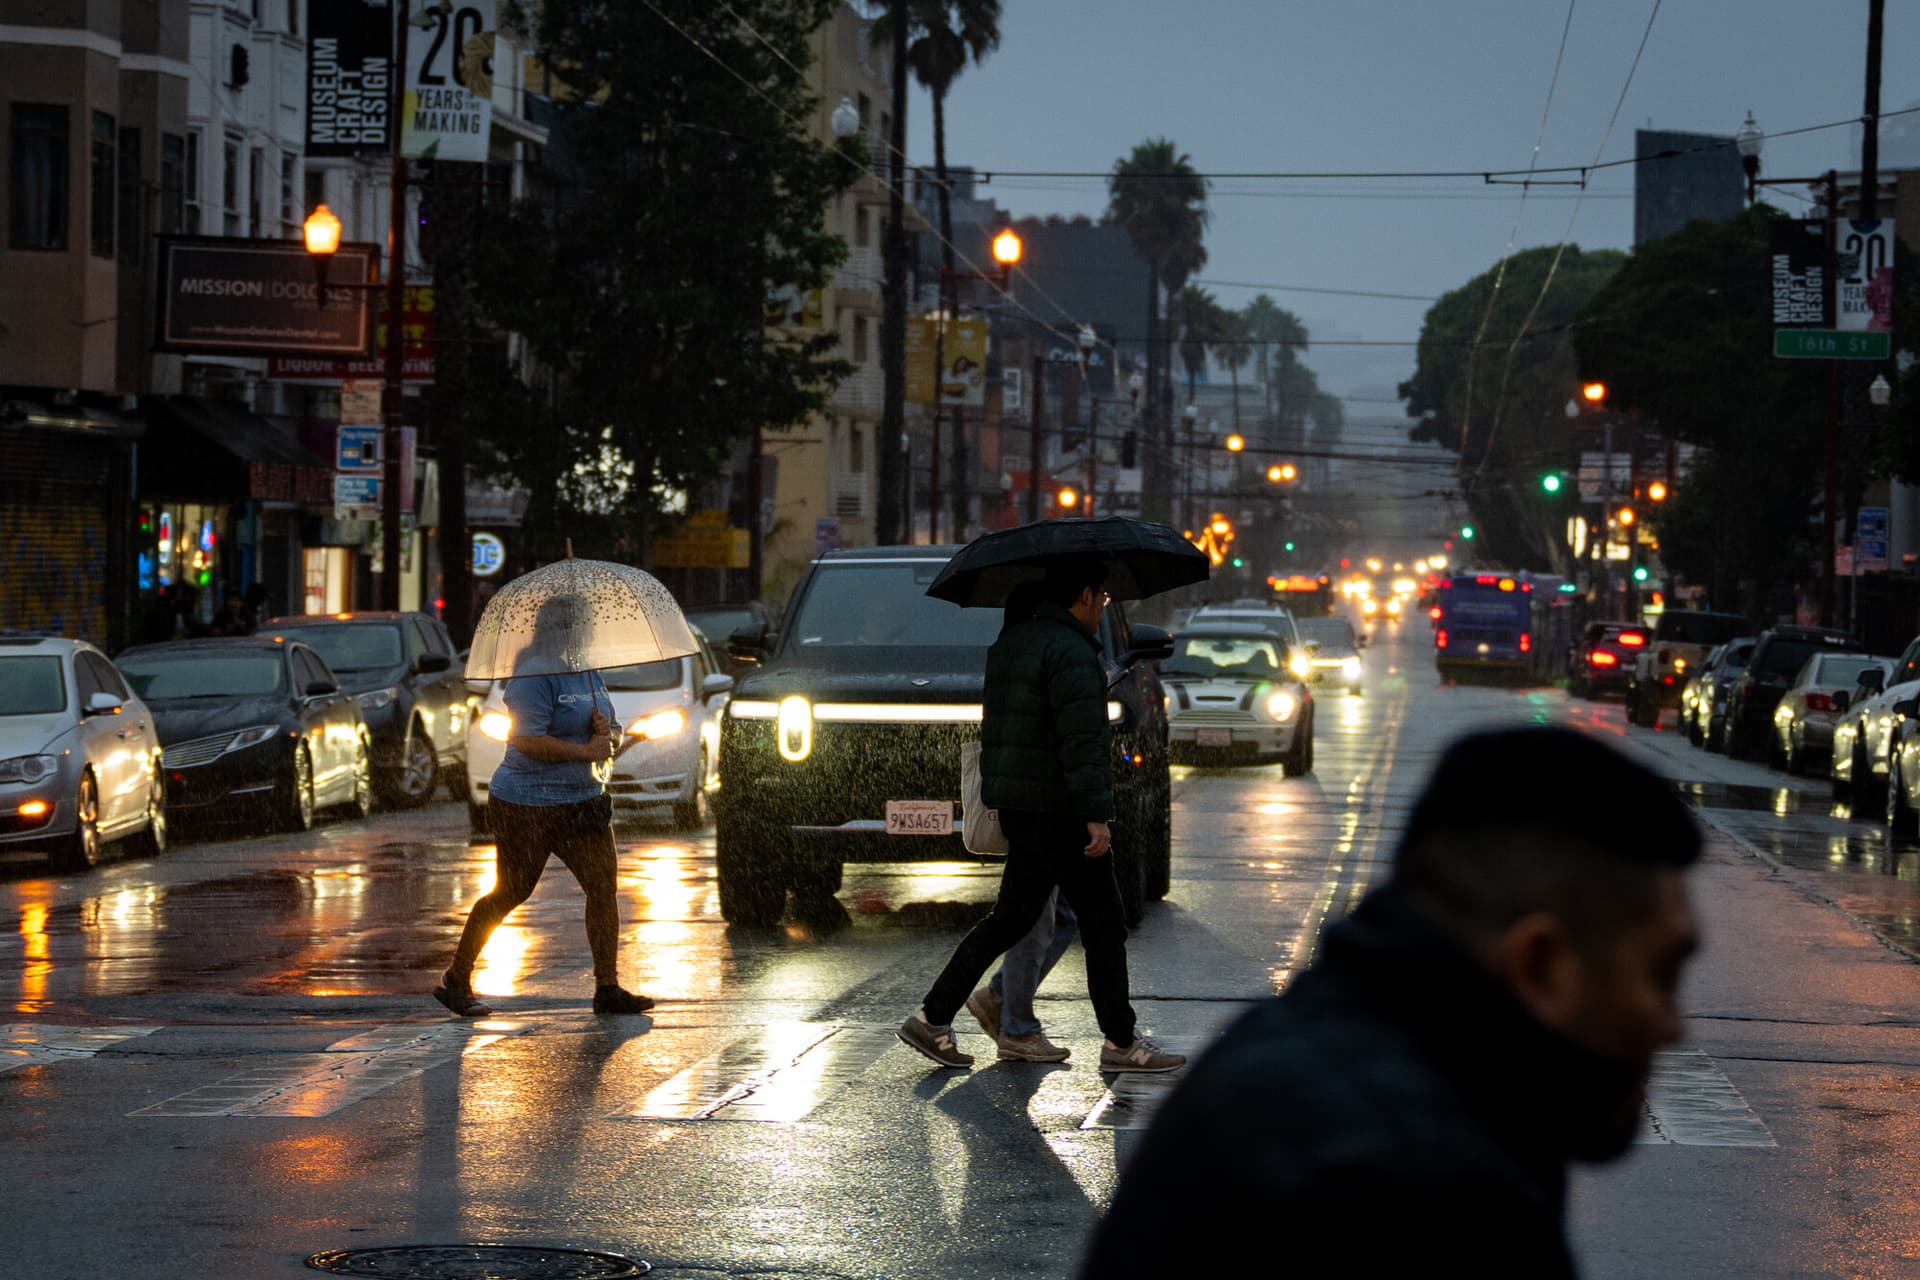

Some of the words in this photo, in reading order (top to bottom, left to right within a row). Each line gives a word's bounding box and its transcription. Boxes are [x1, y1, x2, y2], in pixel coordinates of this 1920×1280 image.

[418, 6, 482, 86] 20
[311, 37, 338, 144] MUSEUM
[336, 68, 362, 144] CRAFT
[361, 57, 388, 144] DESIGN
[416, 88, 464, 110] YEARS
[414, 111, 480, 134] MAKING
[1845, 234, 1885, 284] 20
[179, 278, 263, 297] MISSION
[271, 281, 353, 301] DOLOES
[1772, 254, 1790, 323] MUSEUM
[1790, 274, 1806, 323] CRAFT
[1805, 265, 1823, 323] DESIGN
[1797, 336, 1837, 351] 18th
[1849, 336, 1869, 352] St
[890, 813, 948, 829] 9WSA657
